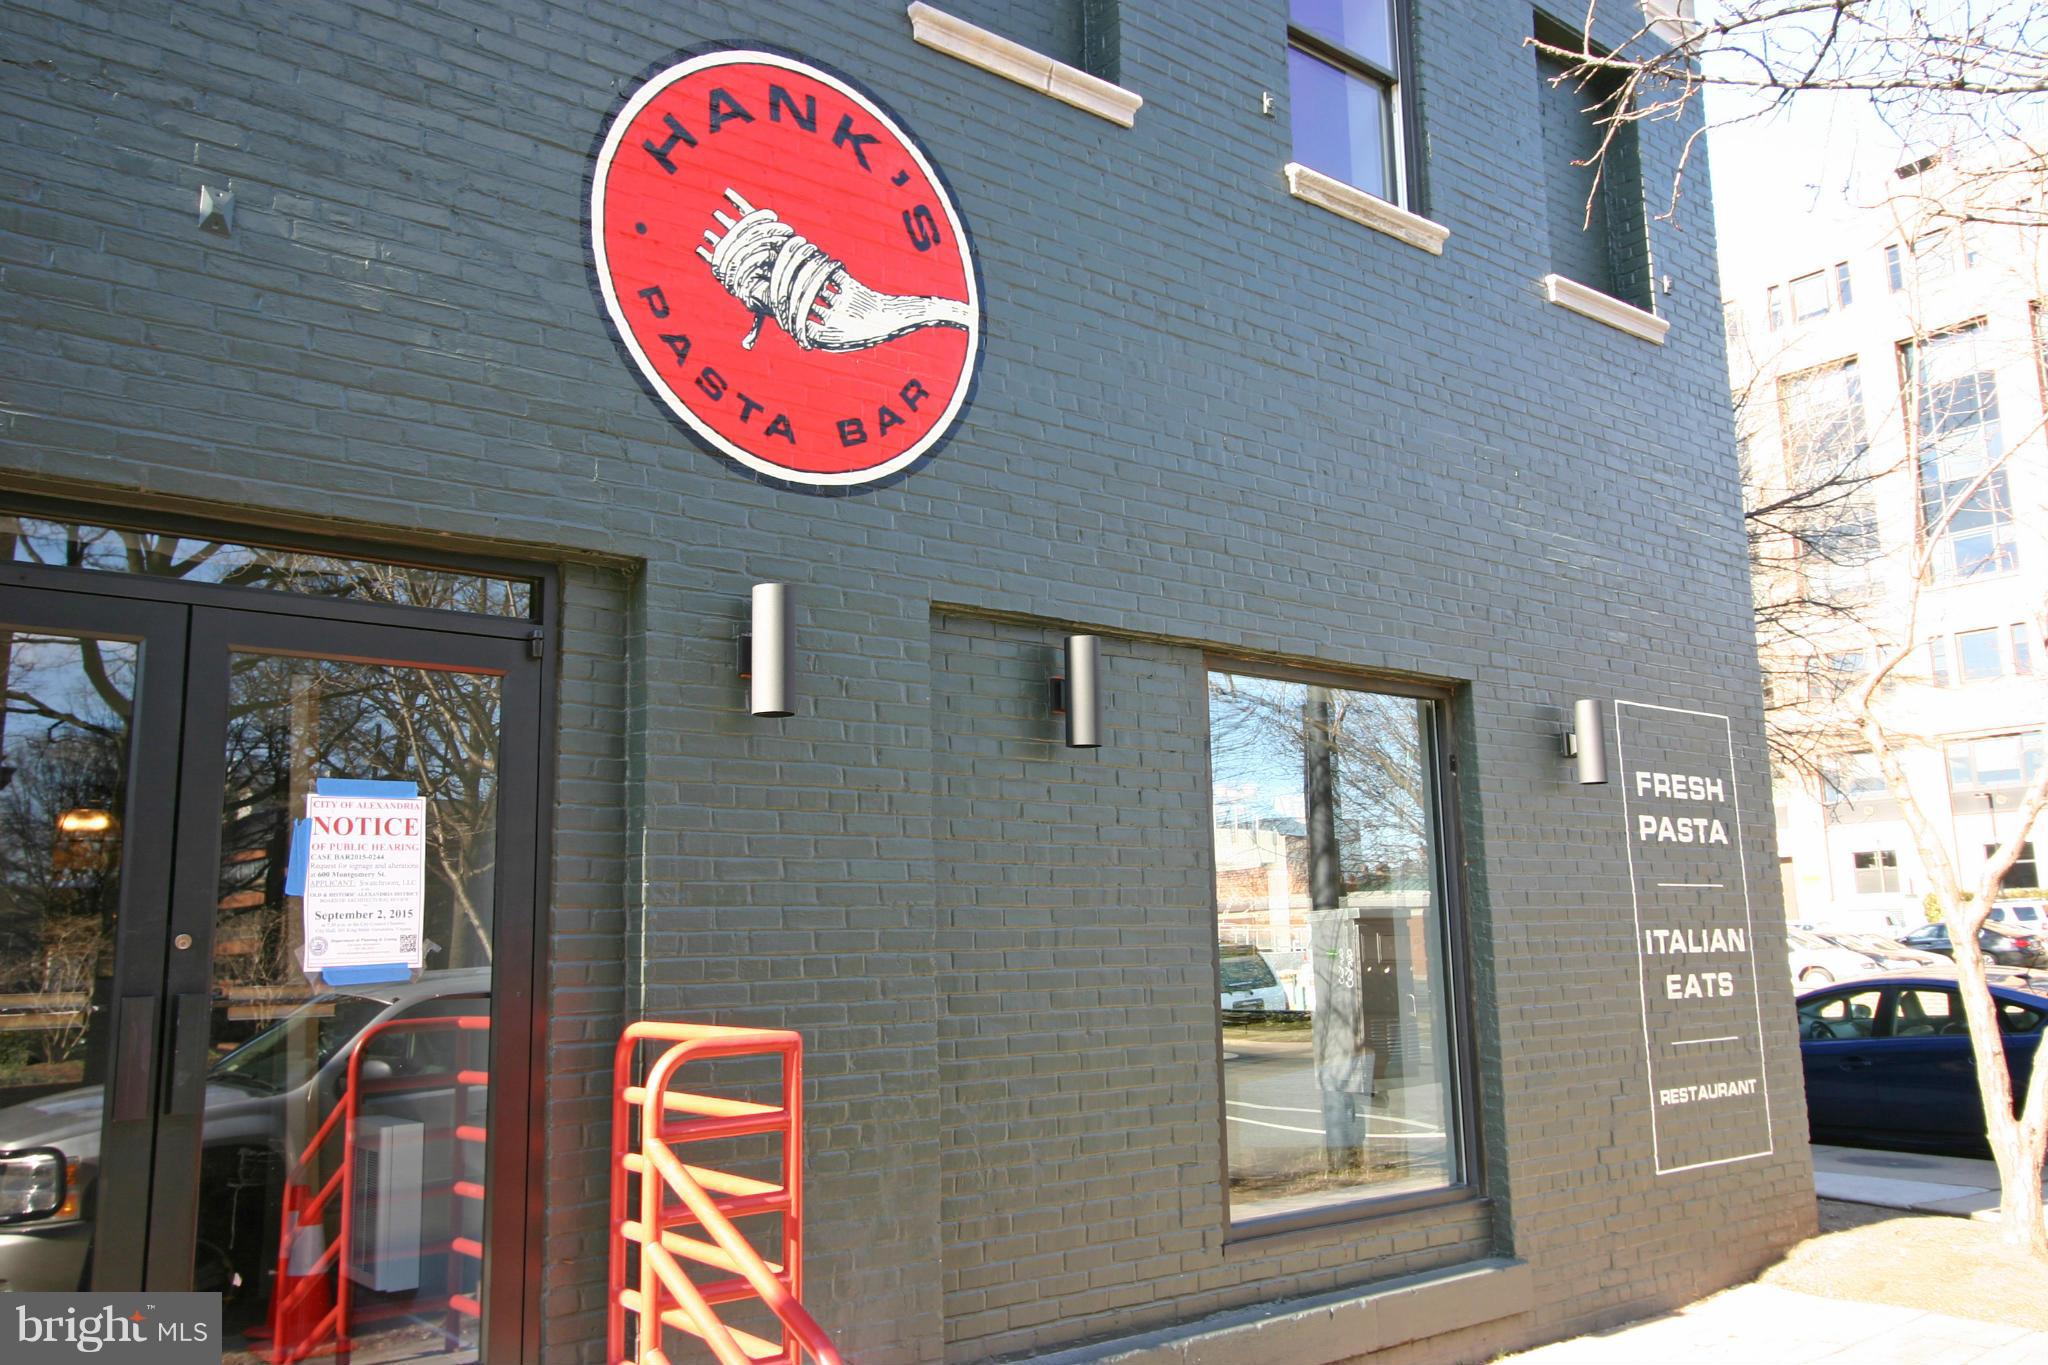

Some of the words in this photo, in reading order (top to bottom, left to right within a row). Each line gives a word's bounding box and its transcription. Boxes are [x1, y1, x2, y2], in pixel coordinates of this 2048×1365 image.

[641, 84, 941, 253] HANK'S
[638, 285, 798, 445] PASTA
[836, 377, 930, 447] BAR
[1636, 771, 1725, 802] FRESH
[313, 800, 337, 808] CITY
[340, 800, 353, 809] OF
[358, 801, 420, 810] ALEXANDRIA
[312, 816, 419, 836] NOTICE
[1638, 815, 1729, 845] PASTA
[311, 843, 327, 851] OF
[329, 843, 368, 851] PUBLIC
[371, 843, 419, 851] HEARING
[332, 871, 375, 879] Montgomery
[315, 910, 373, 922] September
[377, 909, 386, 920] 2,
[390, 909, 413, 919] 2015
[1645, 928, 1746, 954] ITALIAN
[1666, 972, 1734, 999] EATS
[1659, 1079, 1757, 1106] RESTAURANT
